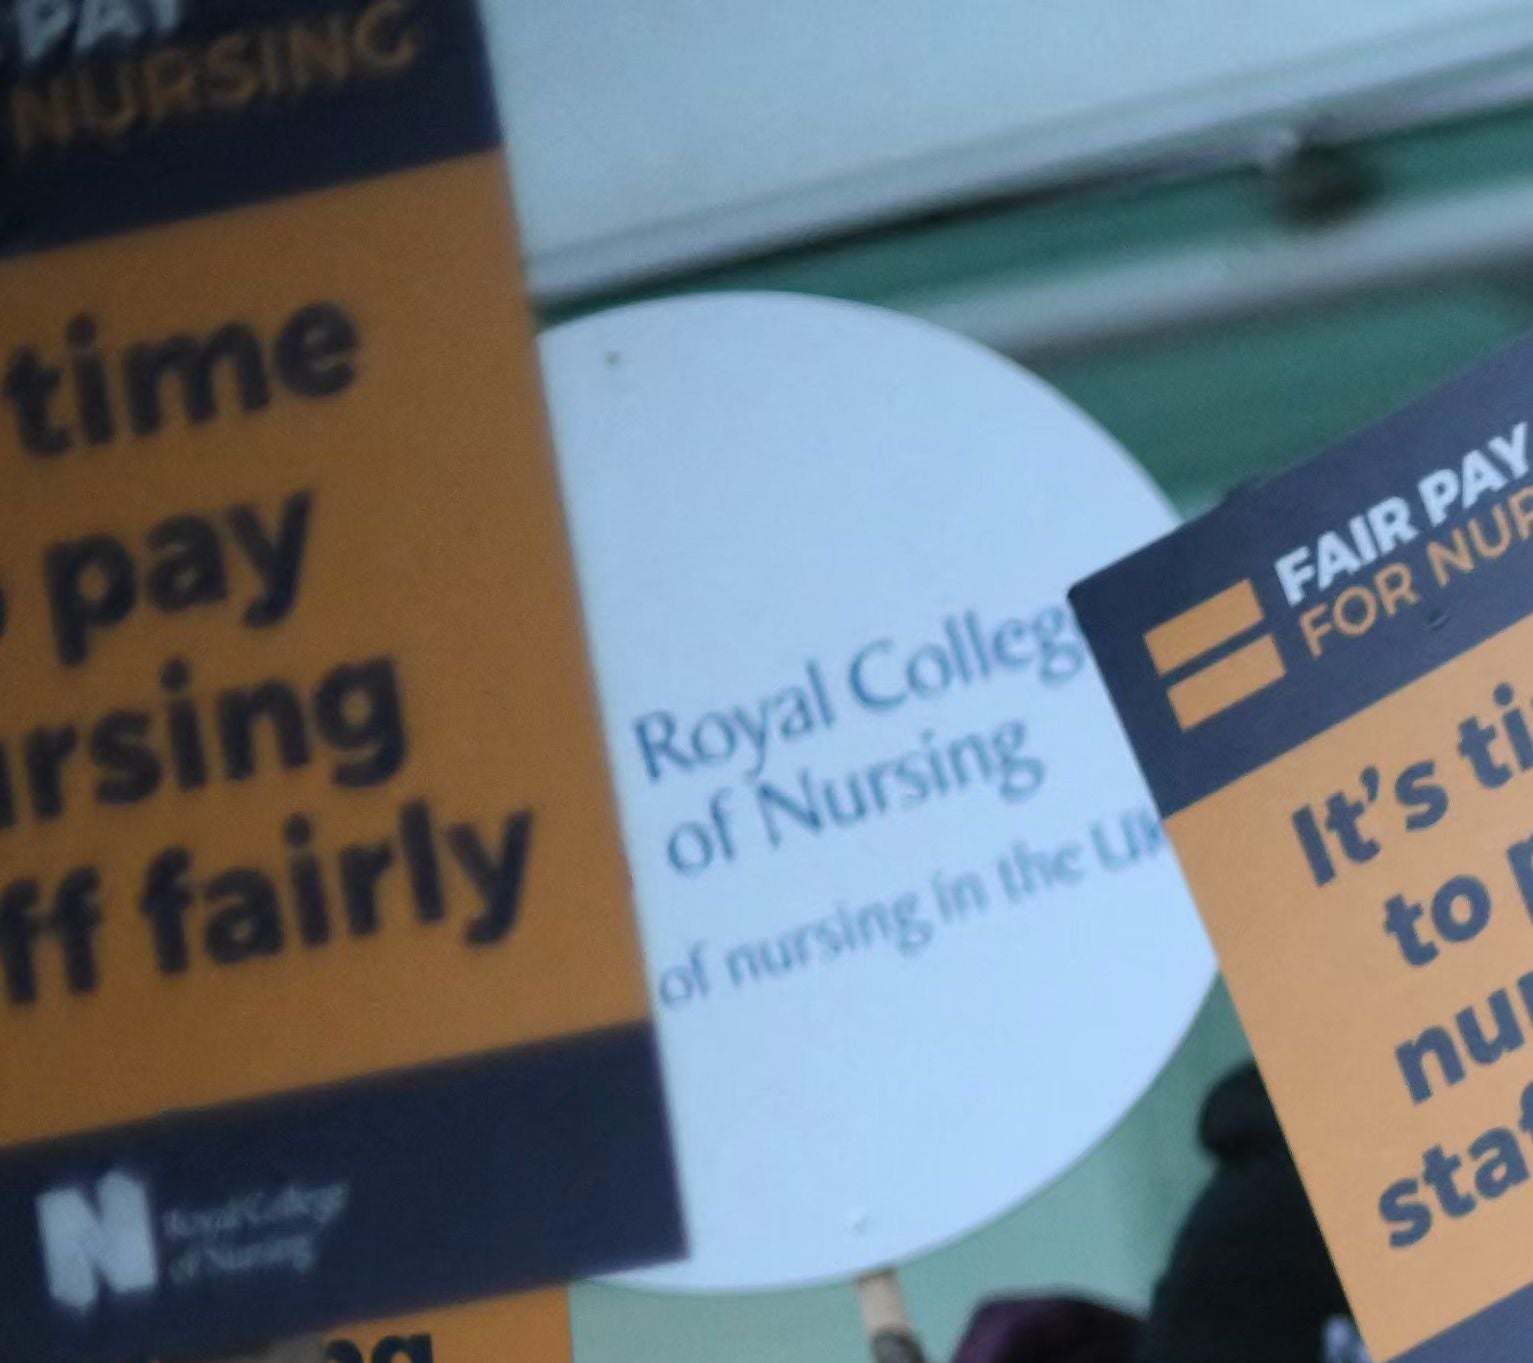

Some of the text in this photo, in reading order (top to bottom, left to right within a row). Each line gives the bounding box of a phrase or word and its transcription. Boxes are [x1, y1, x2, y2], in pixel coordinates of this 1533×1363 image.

[2, 301, 360, 458] time
[42, 490, 313, 668] pay
[1275, 422, 1532, 606] FAIR PAY
[631, 606, 1086, 783] Royal Colleg
[1301, 562, 1422, 662] FOR
[0, 655, 408, 832] rsing
[666, 717, 1047, 877] of Nursing
[140, 798, 536, 978] fairly
[658, 939, 711, 1011] of
[724, 889, 934, 988] nursing
[934, 868, 990, 926] in
[996, 840, 1086, 903] the
[1384, 873, 1492, 968] to
